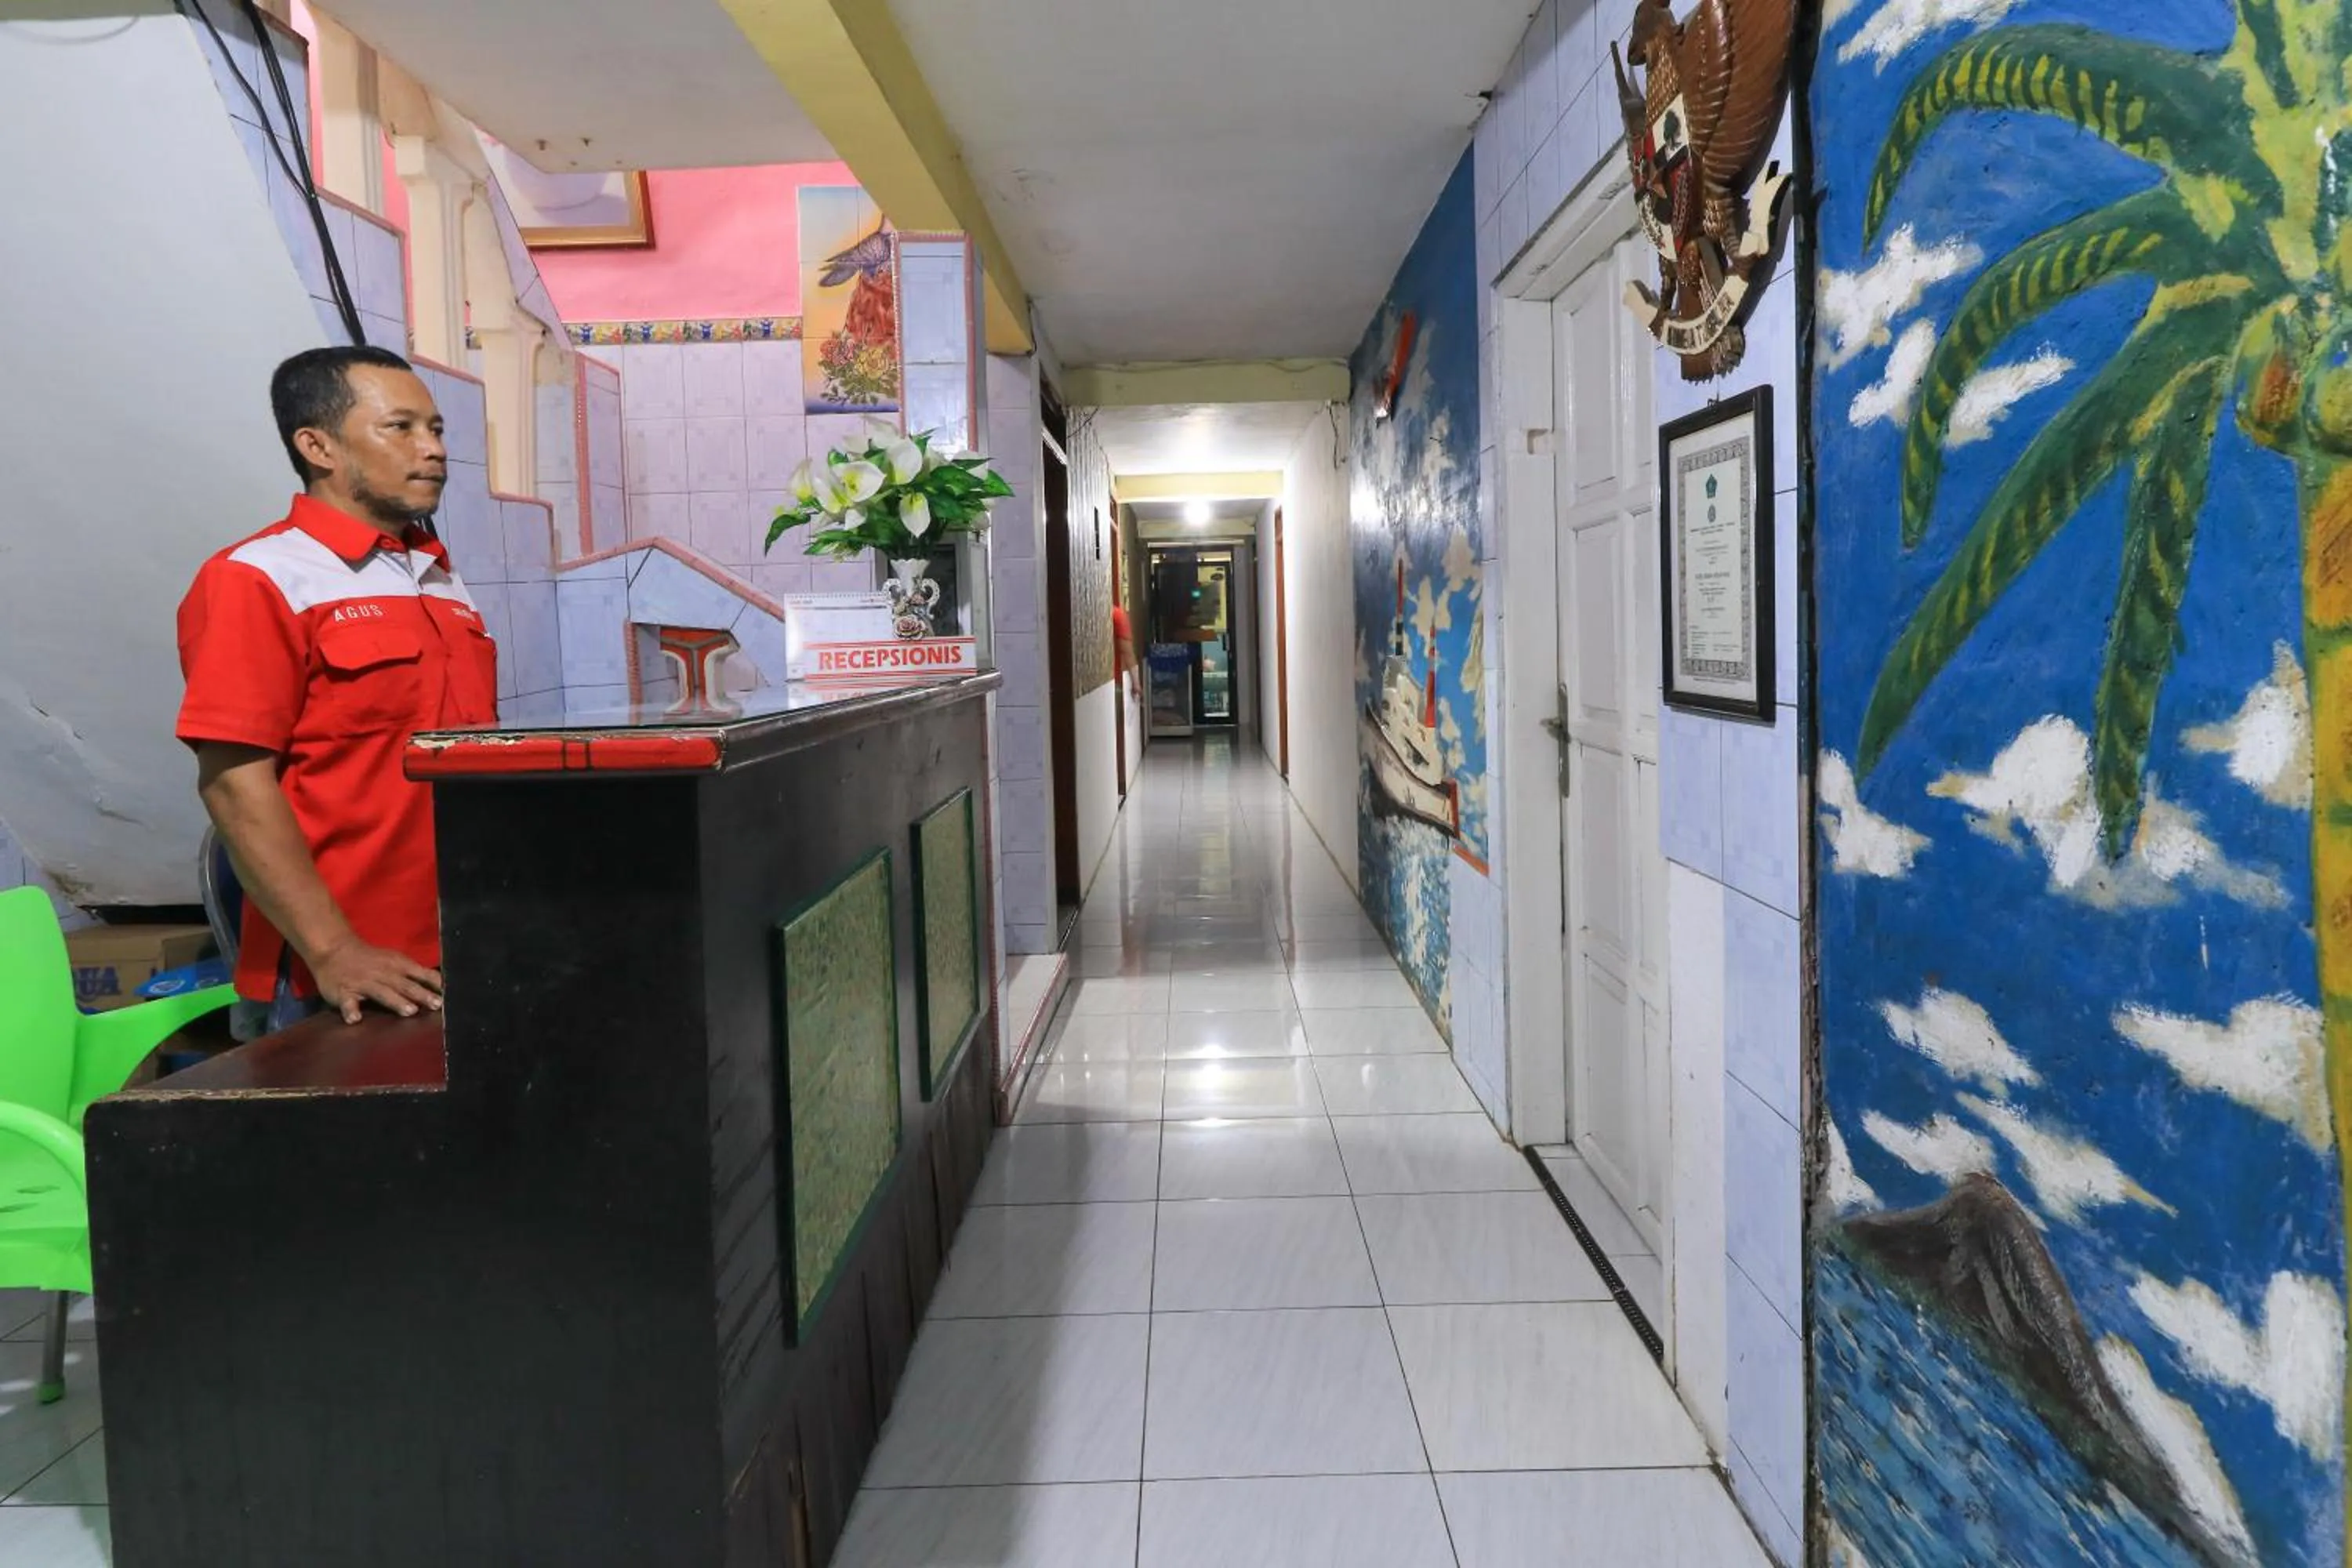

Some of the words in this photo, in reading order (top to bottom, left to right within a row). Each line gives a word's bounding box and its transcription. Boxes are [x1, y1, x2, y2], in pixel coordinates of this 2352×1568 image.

[334, 604, 383, 622] AGUS
[818, 645, 962, 670] RECEPSIONIS
[76, 967, 122, 1000] UA
